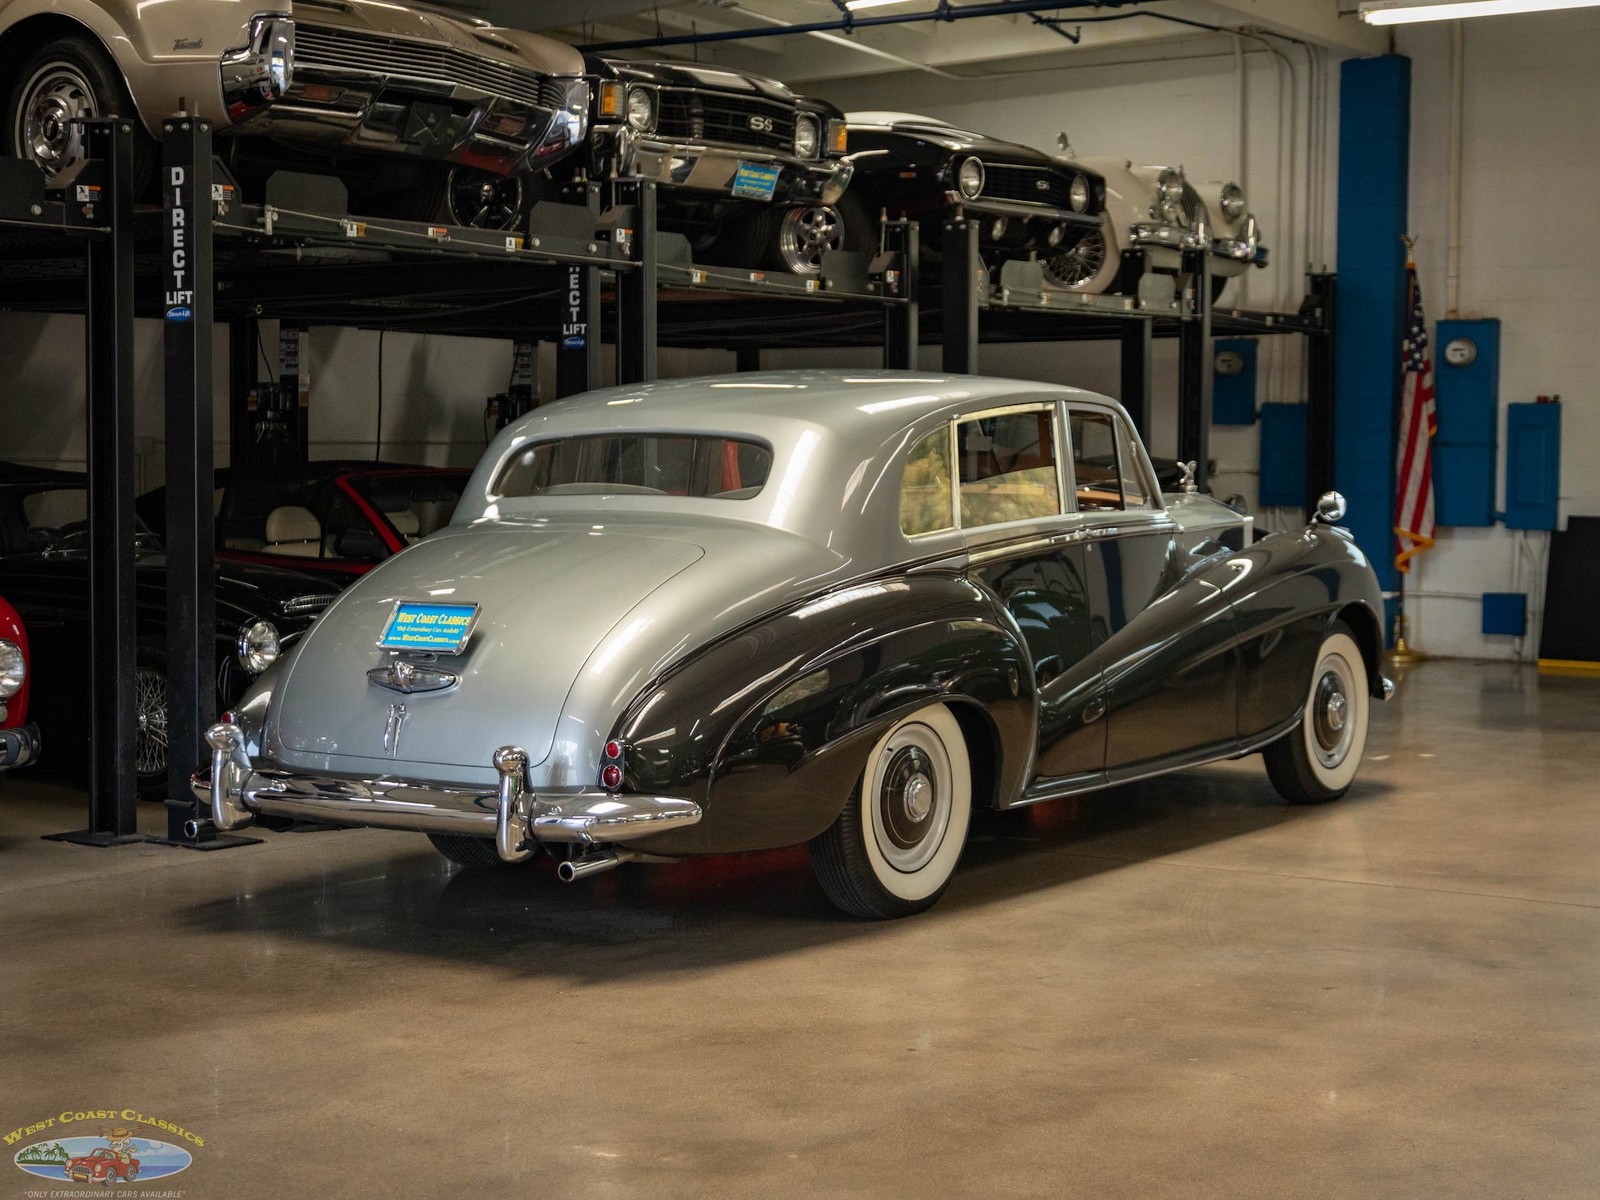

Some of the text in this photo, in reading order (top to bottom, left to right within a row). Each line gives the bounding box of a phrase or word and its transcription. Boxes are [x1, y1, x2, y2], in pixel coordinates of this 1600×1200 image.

[750, 116, 773, 131] SS
[171, 167, 185, 289] DIRECT
[166, 291, 193, 305] LIFT
[563, 323, 587, 335] LIFT
